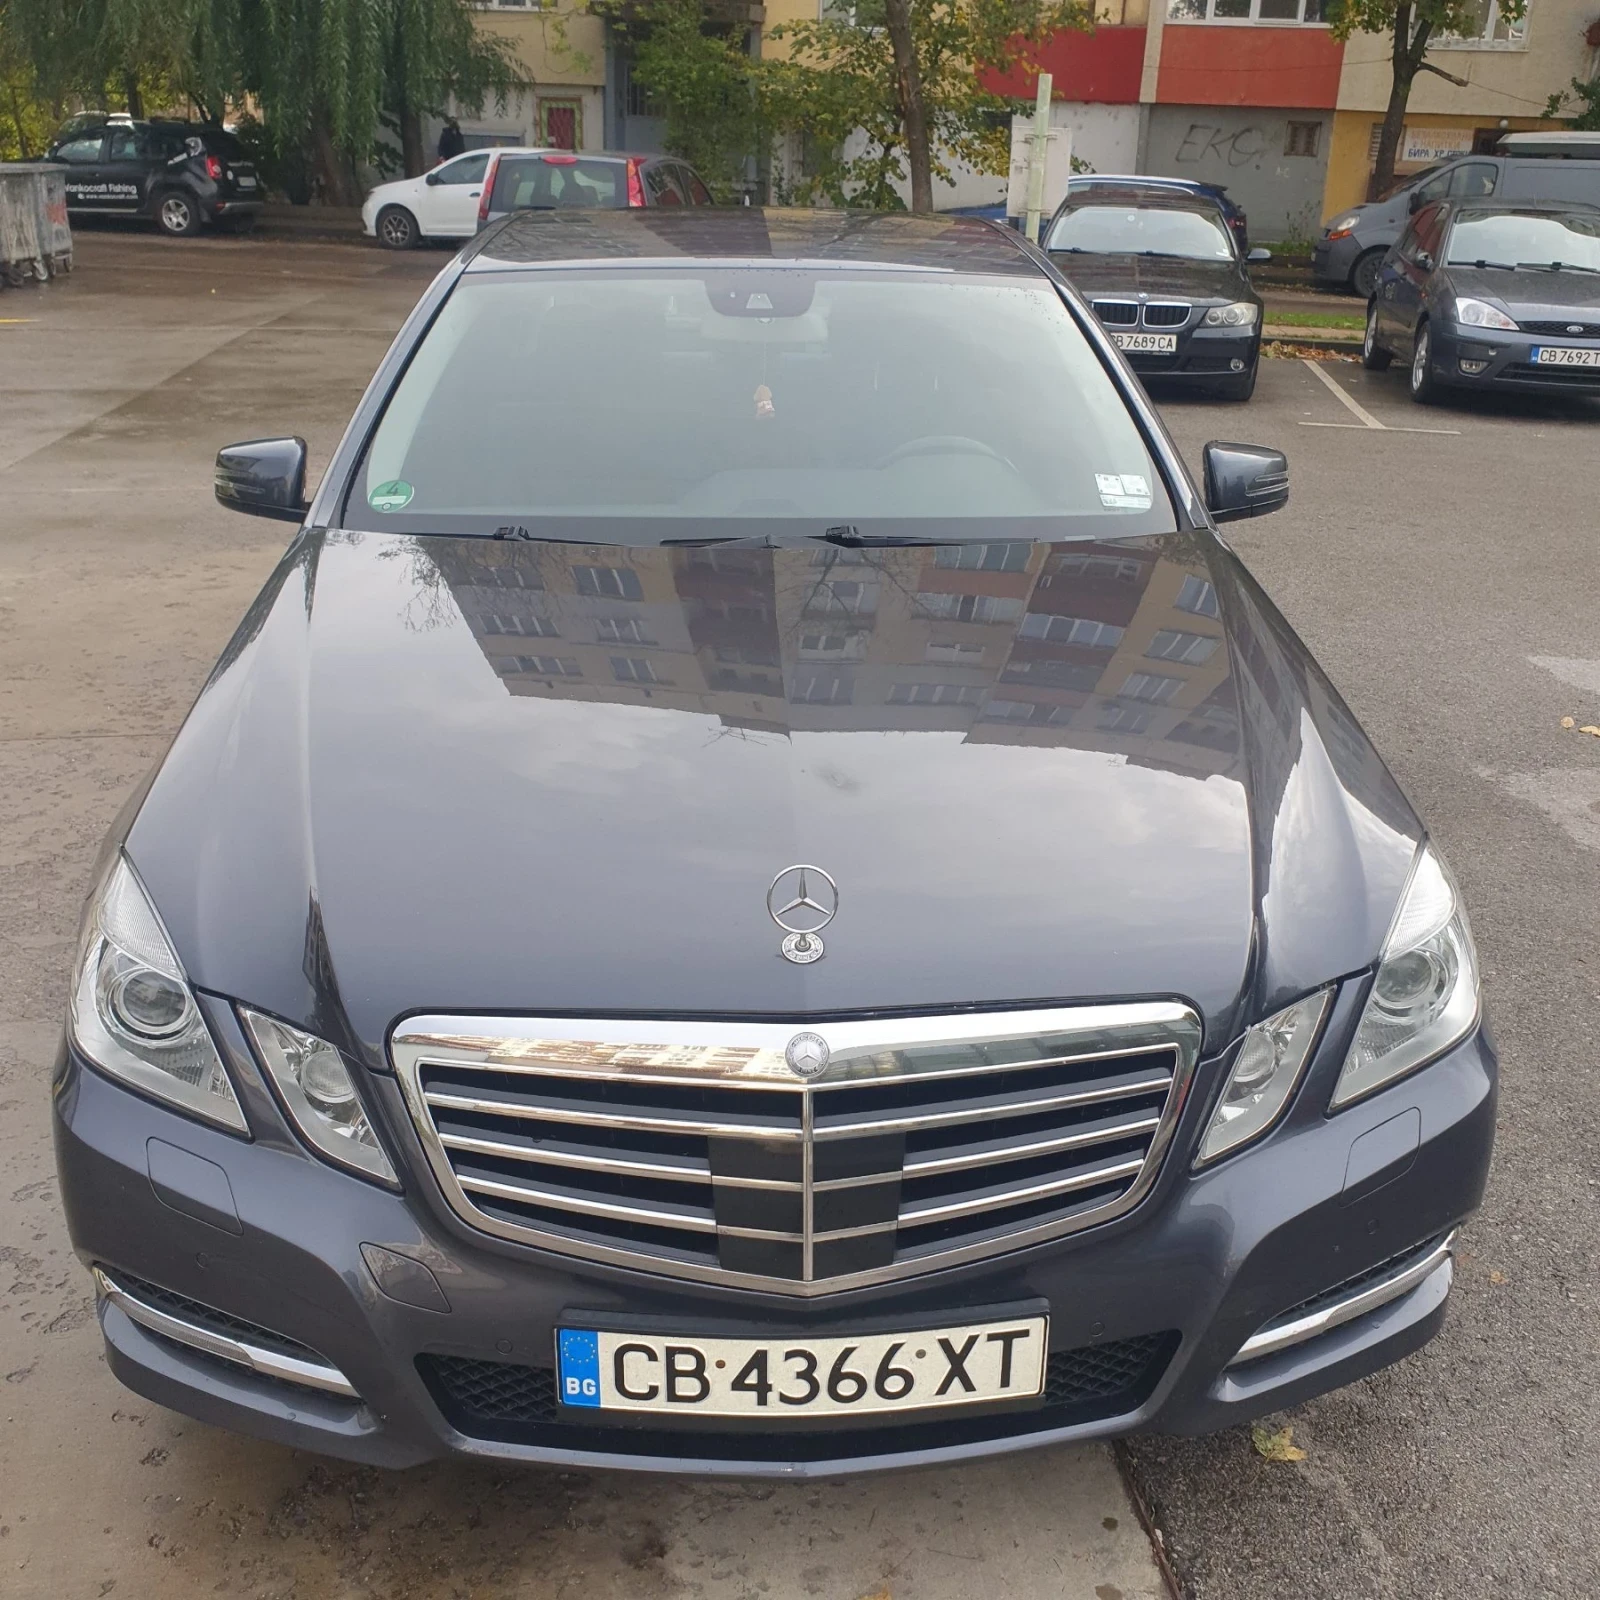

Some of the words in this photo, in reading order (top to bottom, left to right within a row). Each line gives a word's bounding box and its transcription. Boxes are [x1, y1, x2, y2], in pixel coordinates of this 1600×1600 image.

[1408, 148, 1430, 158] БИРА
[108, 183, 138, 195] Fishing
[1126, 336, 1156, 349] 7689
[1158, 337, 1174, 350] CA
[1540, 349, 1557, 363] CB
[1559, 350, 1590, 364] 7692
[386, 482, 399, 496] 4
[613, 1342, 710, 1404] CB
[731, 1342, 916, 1406] 4366
[934, 1328, 1031, 1396] XT
[566, 1377, 597, 1397] BG
